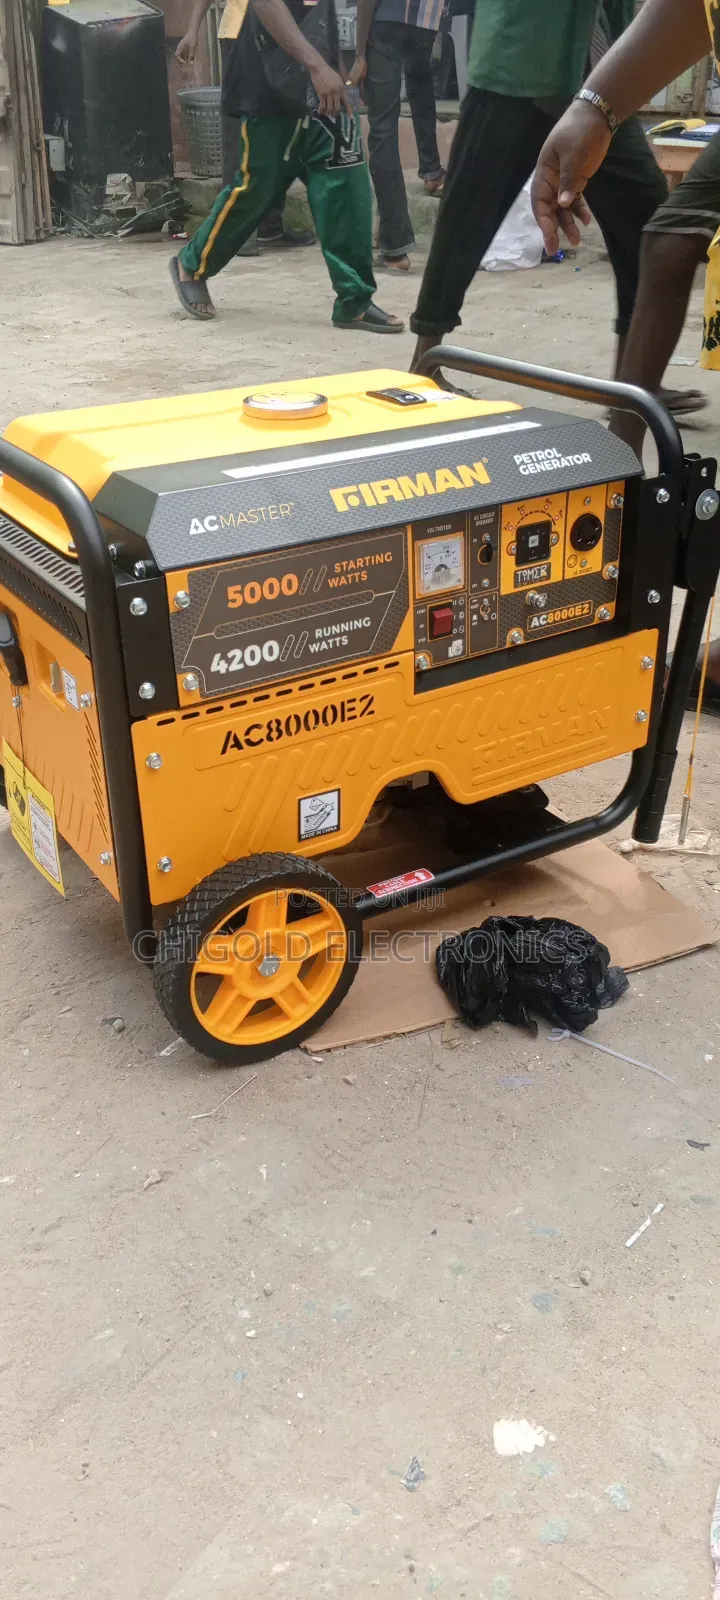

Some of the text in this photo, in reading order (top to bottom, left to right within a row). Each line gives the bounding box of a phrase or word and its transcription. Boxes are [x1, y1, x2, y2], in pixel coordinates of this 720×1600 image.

[513, 448, 562, 465] PETROL
[519, 453, 593, 475] GENERATOR
[329, 461, 492, 513] FIRMAN
[426, 524, 452, 534] VOLTMETER
[475, 518, 494, 527] BREAKER
[334, 551, 393, 574] STARTING
[227, 573, 299, 609] 5000
[328, 571, 368, 589] WATTS
[531, 603, 590, 628] AC8000E2
[314, 617, 372, 640] RUNNING
[308, 635, 349, 654] WATTS
[210, 640, 280, 675] 4200
[220, 693, 376, 756] AC8000E2
[301, 831, 316, 839] MADE
[322, 825, 338, 834] CHINA
